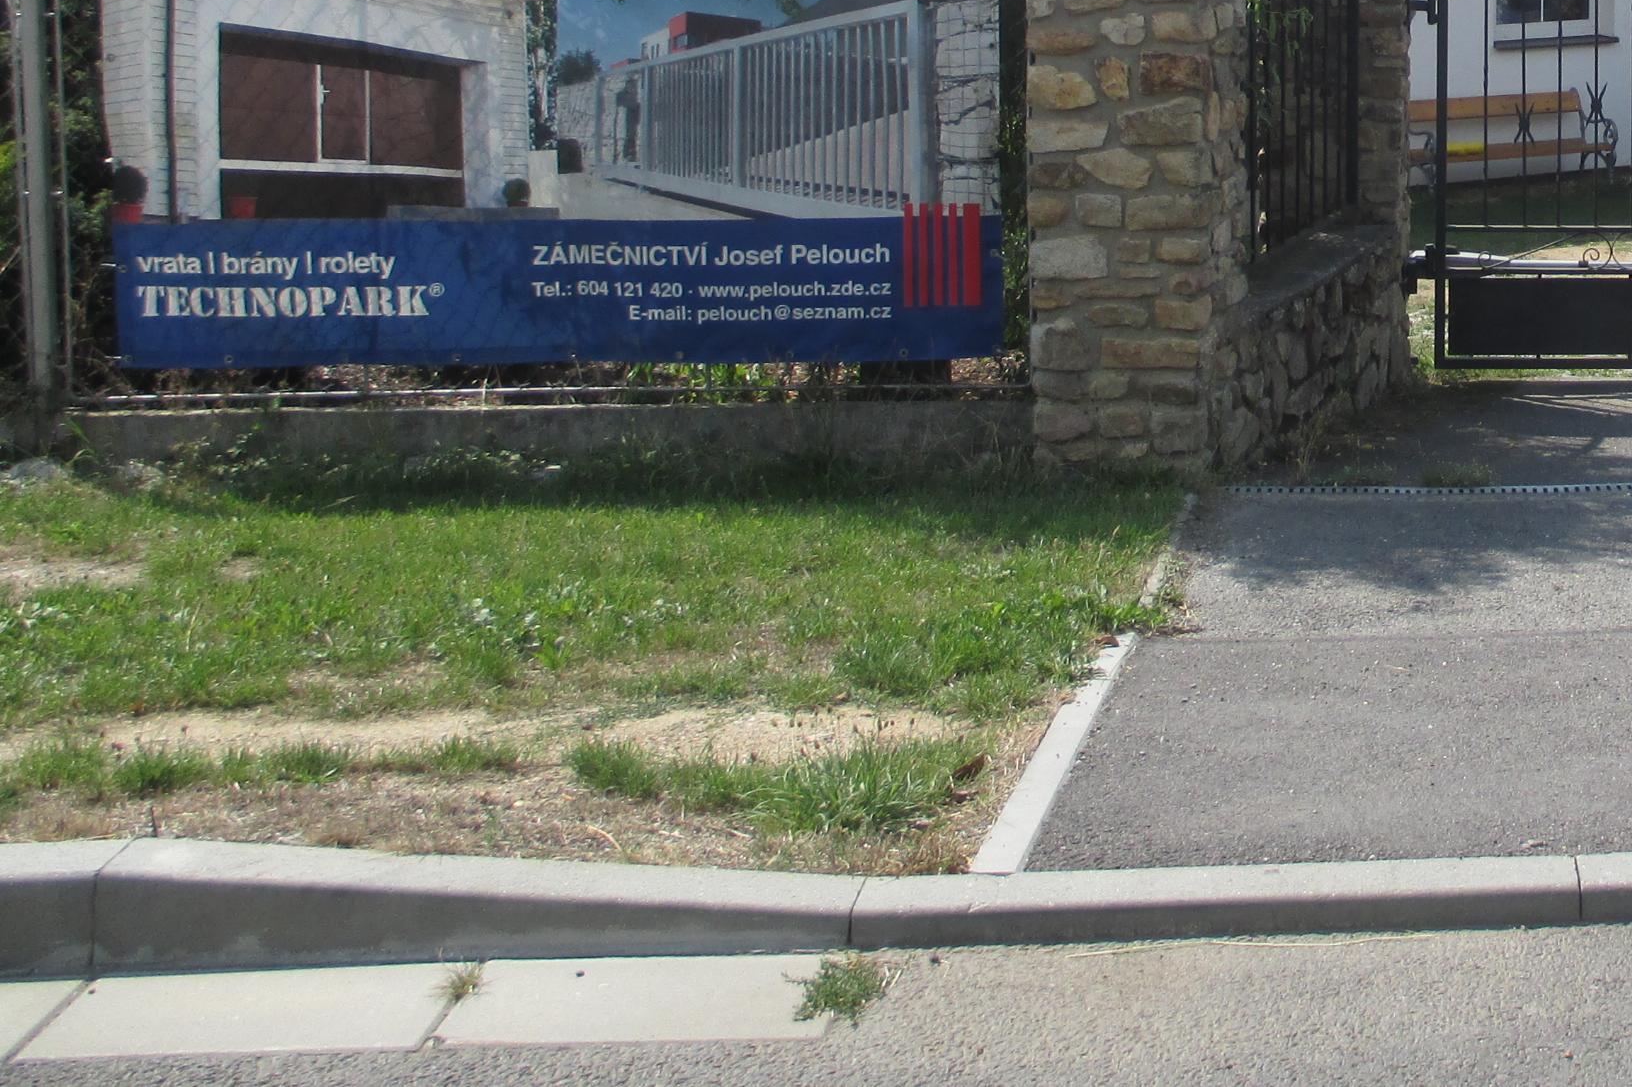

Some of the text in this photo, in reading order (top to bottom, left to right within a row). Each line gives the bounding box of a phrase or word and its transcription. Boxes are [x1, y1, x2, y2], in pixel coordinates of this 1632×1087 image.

[135, 252, 202, 274] vrata
[221, 250, 299, 280] brány
[320, 250, 396, 280] rolety
[532, 241, 890, 266] ZÁMEČNICTVÍ Josef Pelouch
[531, 281, 572, 298] Tel.:
[577, 280, 609, 296] 604
[614, 282, 643, 297] 121
[650, 282, 683, 298] 420
[698, 280, 892, 302] www.pelouch.zde.cz
[628, 303, 892, 325] E-mail: pelouch@seznam.cz
